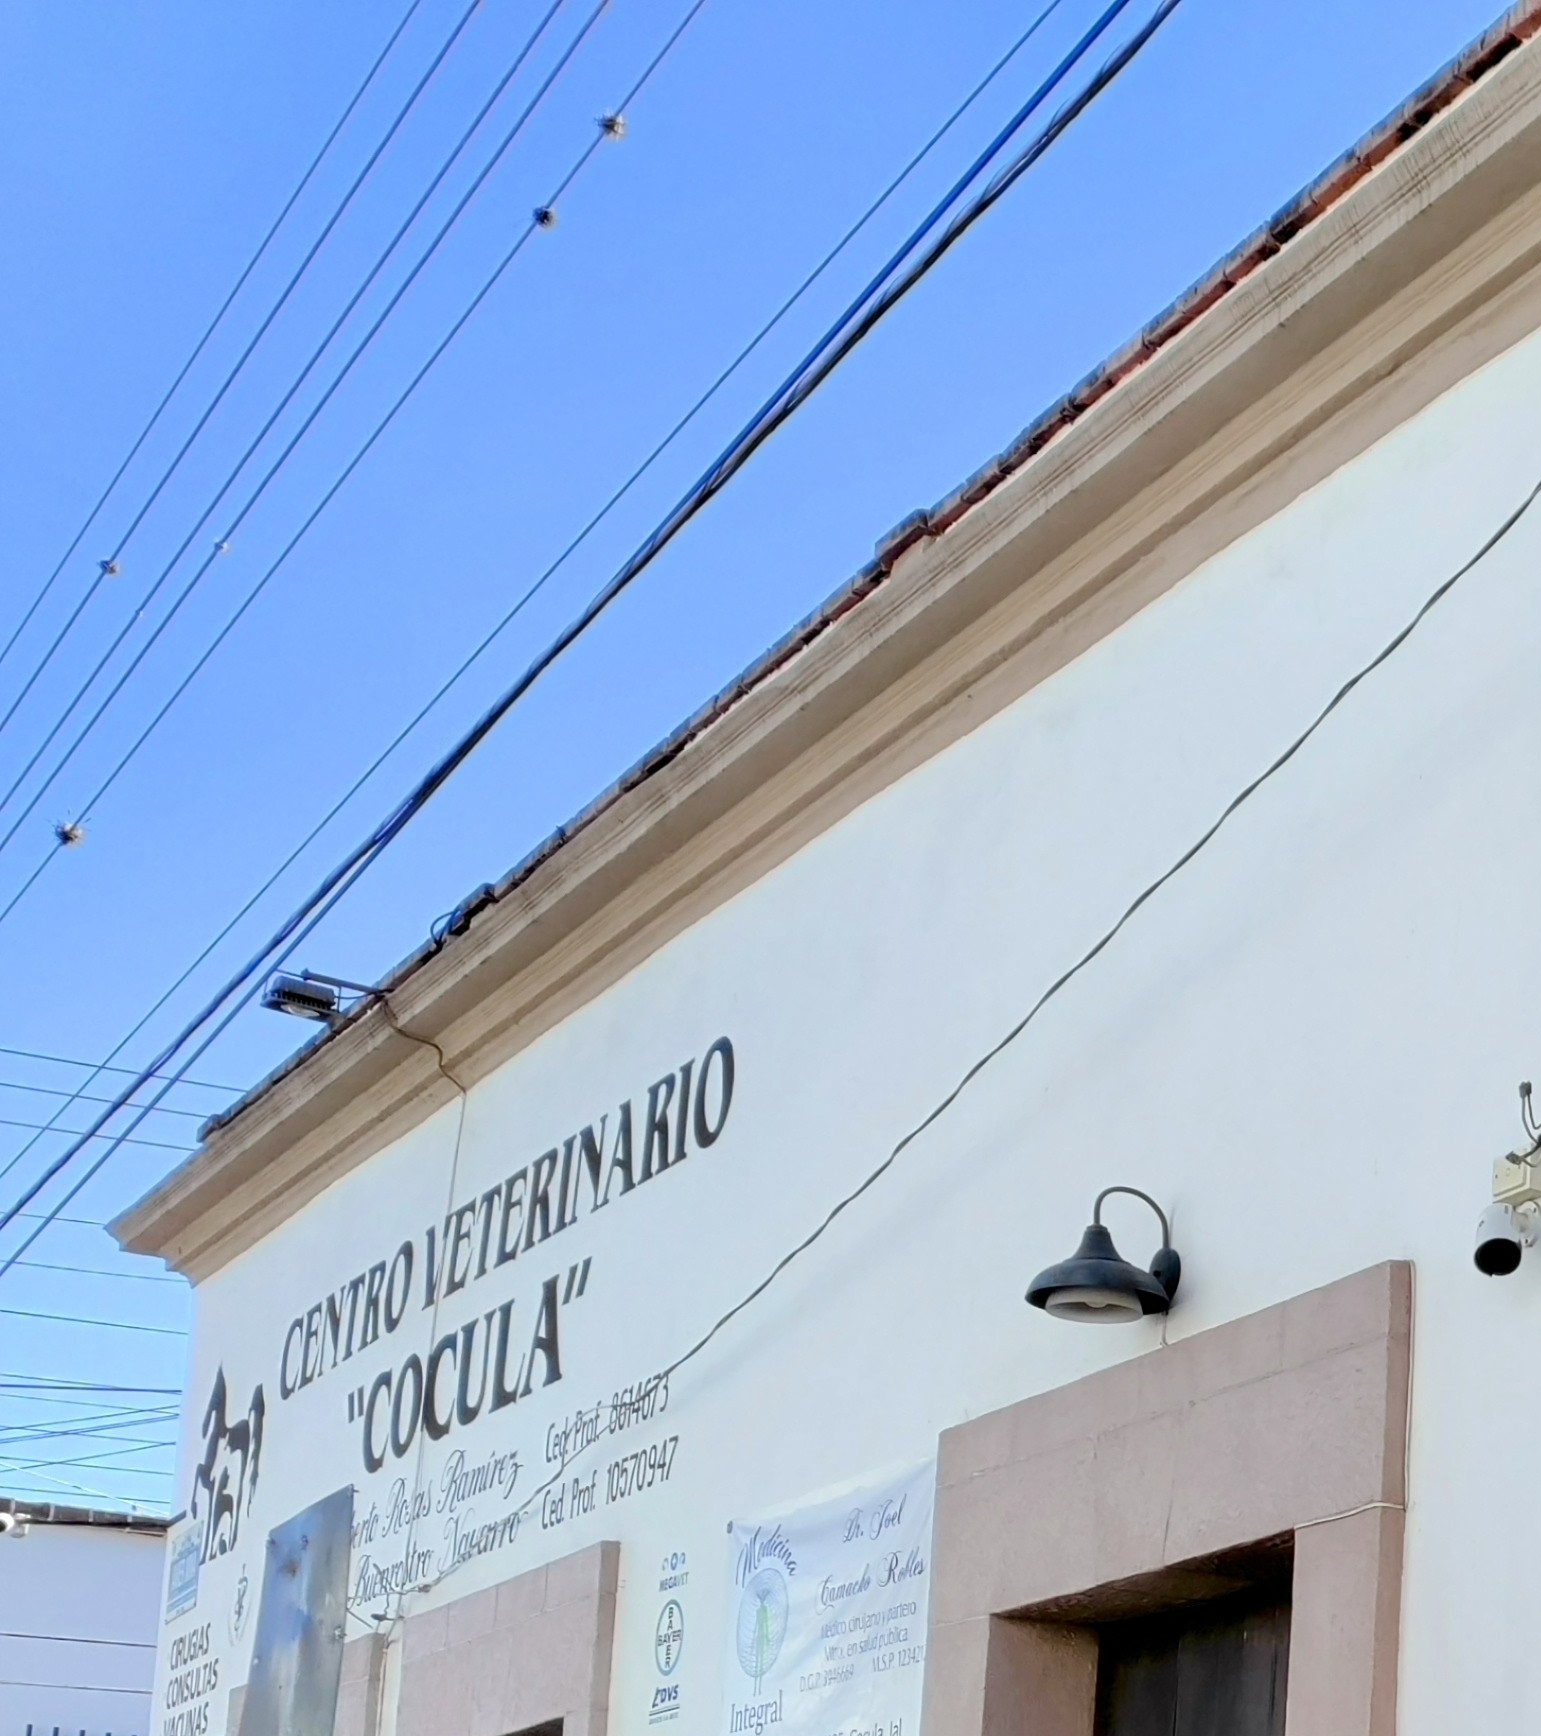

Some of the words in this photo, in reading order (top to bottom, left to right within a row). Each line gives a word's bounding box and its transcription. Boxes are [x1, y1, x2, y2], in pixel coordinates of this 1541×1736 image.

[280, 1241, 414, 1400] CENTRO
[422, 1036, 735, 1309] VETERINARIO
[347, 1256, 592, 1473] "COCULA"
[542, 1483, 564, 1530] Ced.
[570, 1470, 596, 1519] Prof.
[605, 1436, 679, 1505] 10570947
[869, 1493, 907, 1541] Joel
[659, 1572, 689, 1592] MEGAVET
[736, 1524, 797, 1588] Medicina
[815, 1563, 872, 1616] Camacho
[876, 1546, 925, 1588] Robles
[657, 1629, 682, 1646] BAYER
[664, 1607, 674, 1669] BAYER
[887, 1601, 917, 1625] partero
[171, 1622, 211, 1671] CIRUGIAS
[167, 1658, 219, 1710] CONSULTAS
[730, 1690, 783, 1736] Integral
